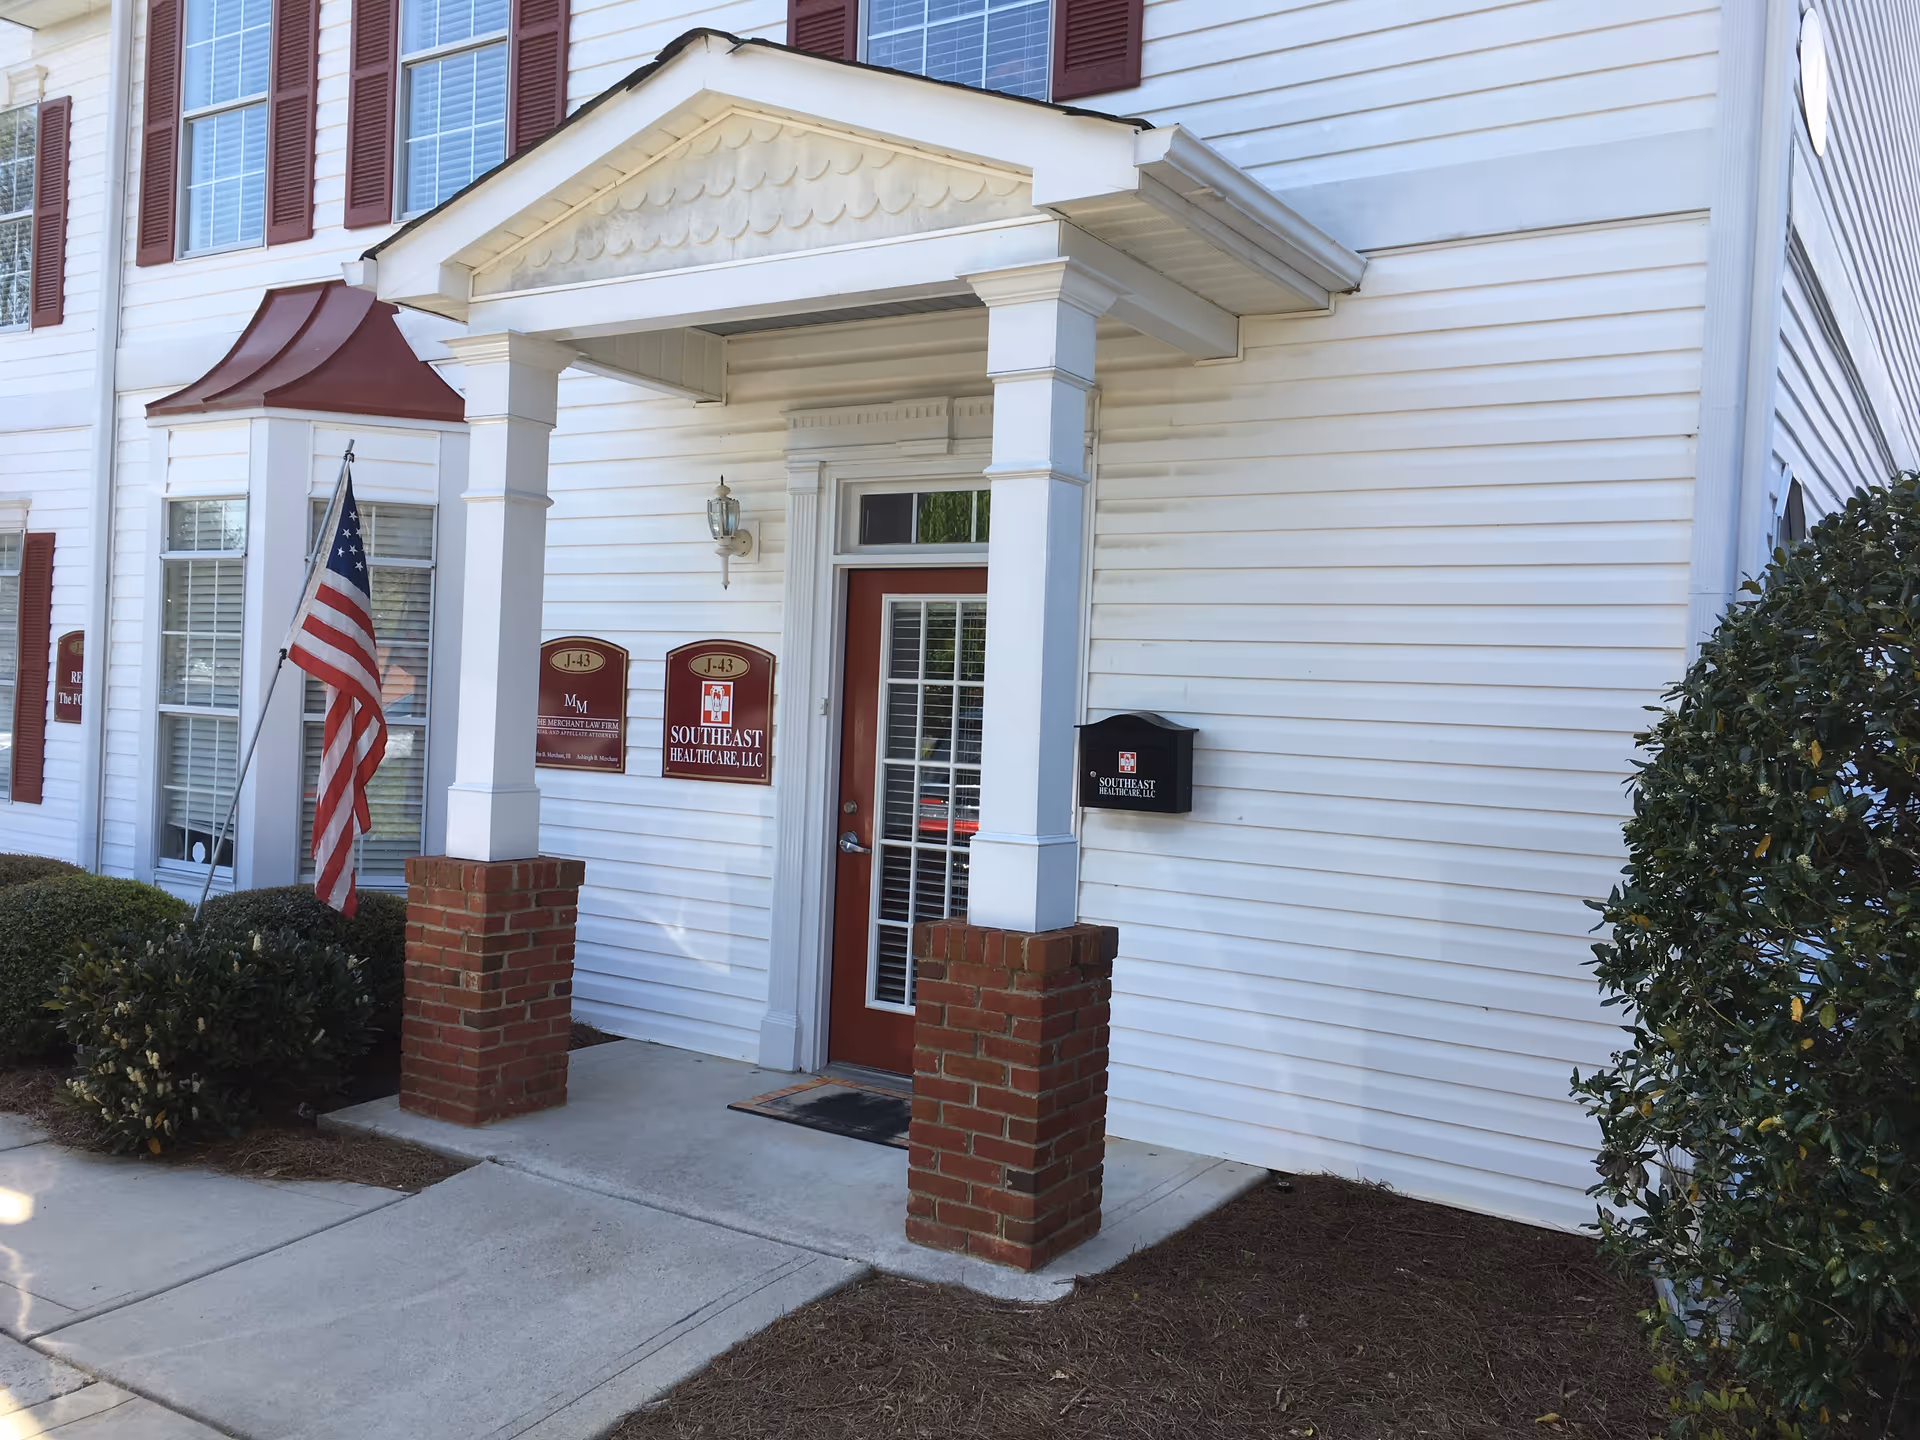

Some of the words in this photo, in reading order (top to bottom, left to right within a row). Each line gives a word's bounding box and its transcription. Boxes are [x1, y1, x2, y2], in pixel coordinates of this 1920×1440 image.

[564, 653, 591, 668] J-43
[704, 657, 733, 673] J-43
[58, 691, 72, 705] The
[537, 718, 547, 726] HE
[548, 719, 585, 728] MERCHANT
[586, 720, 600, 729] LAW
[602, 721, 619, 730] FIRM
[670, 725, 763, 748] SOUTHEAST
[669, 747, 740, 768] HEALTHCARE,
[741, 751, 763, 767] LLC
[1099, 776, 1156, 790] SOUTHEAST
[1099, 787, 1143, 798] HEALTHCARE,
[1143, 789, 1156, 798] LLC
